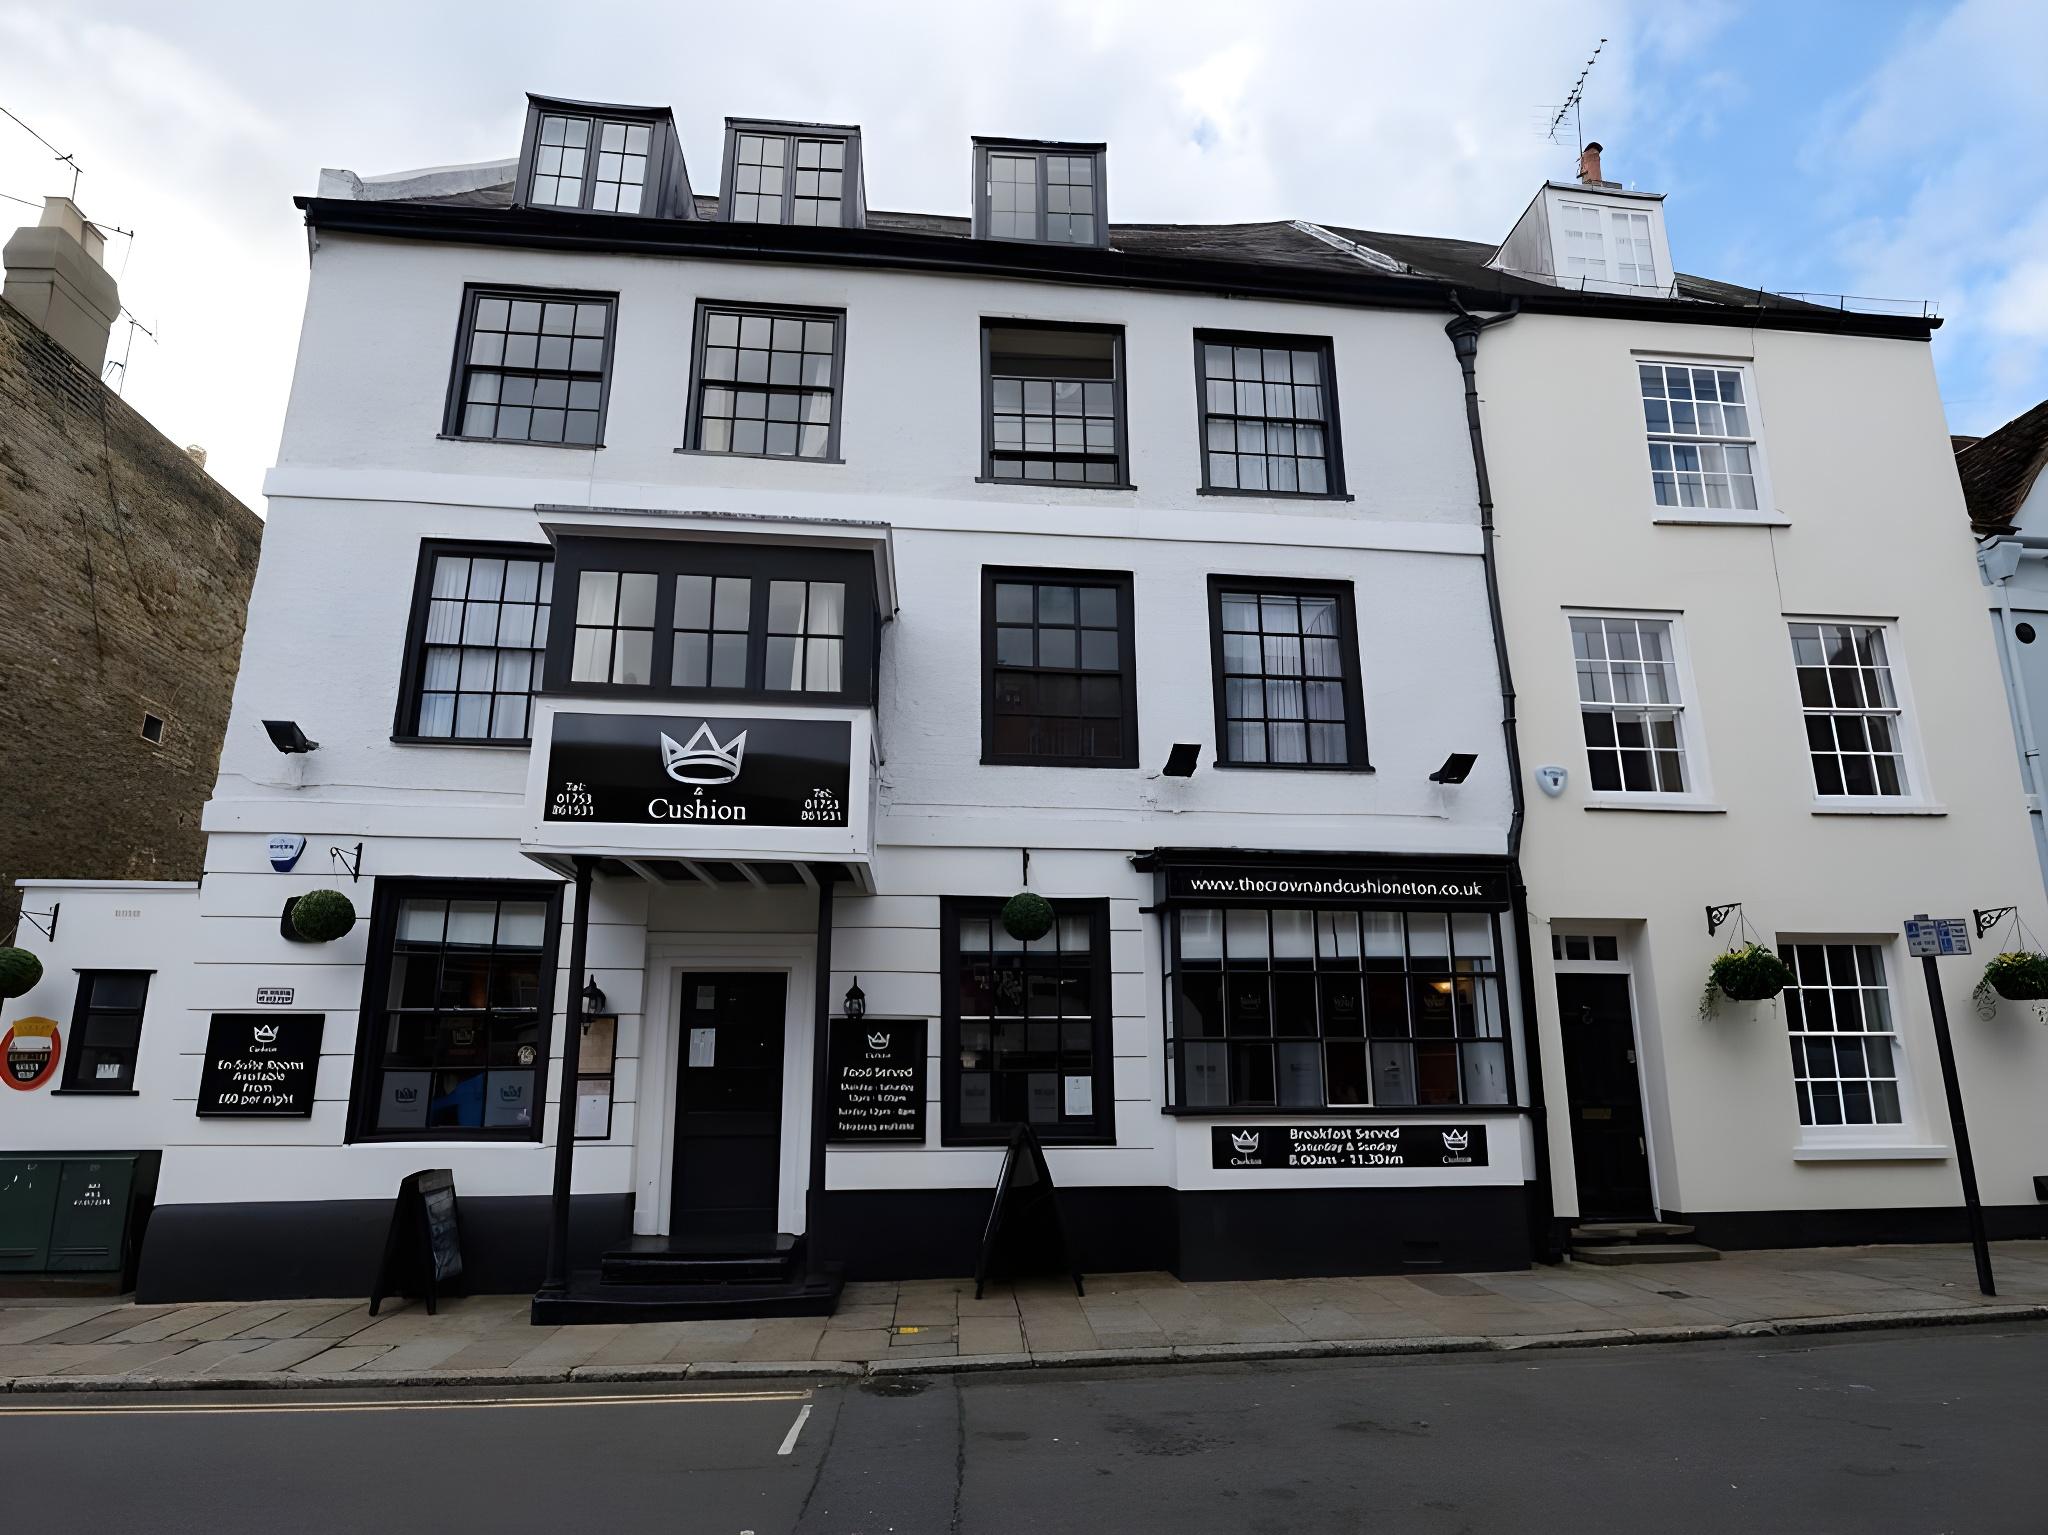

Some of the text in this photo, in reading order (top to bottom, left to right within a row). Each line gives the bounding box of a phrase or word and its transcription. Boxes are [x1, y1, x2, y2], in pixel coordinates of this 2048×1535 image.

[648, 798, 746, 820] Cushion
[1290, 1127, 1400, 1140] Breakfast Served
